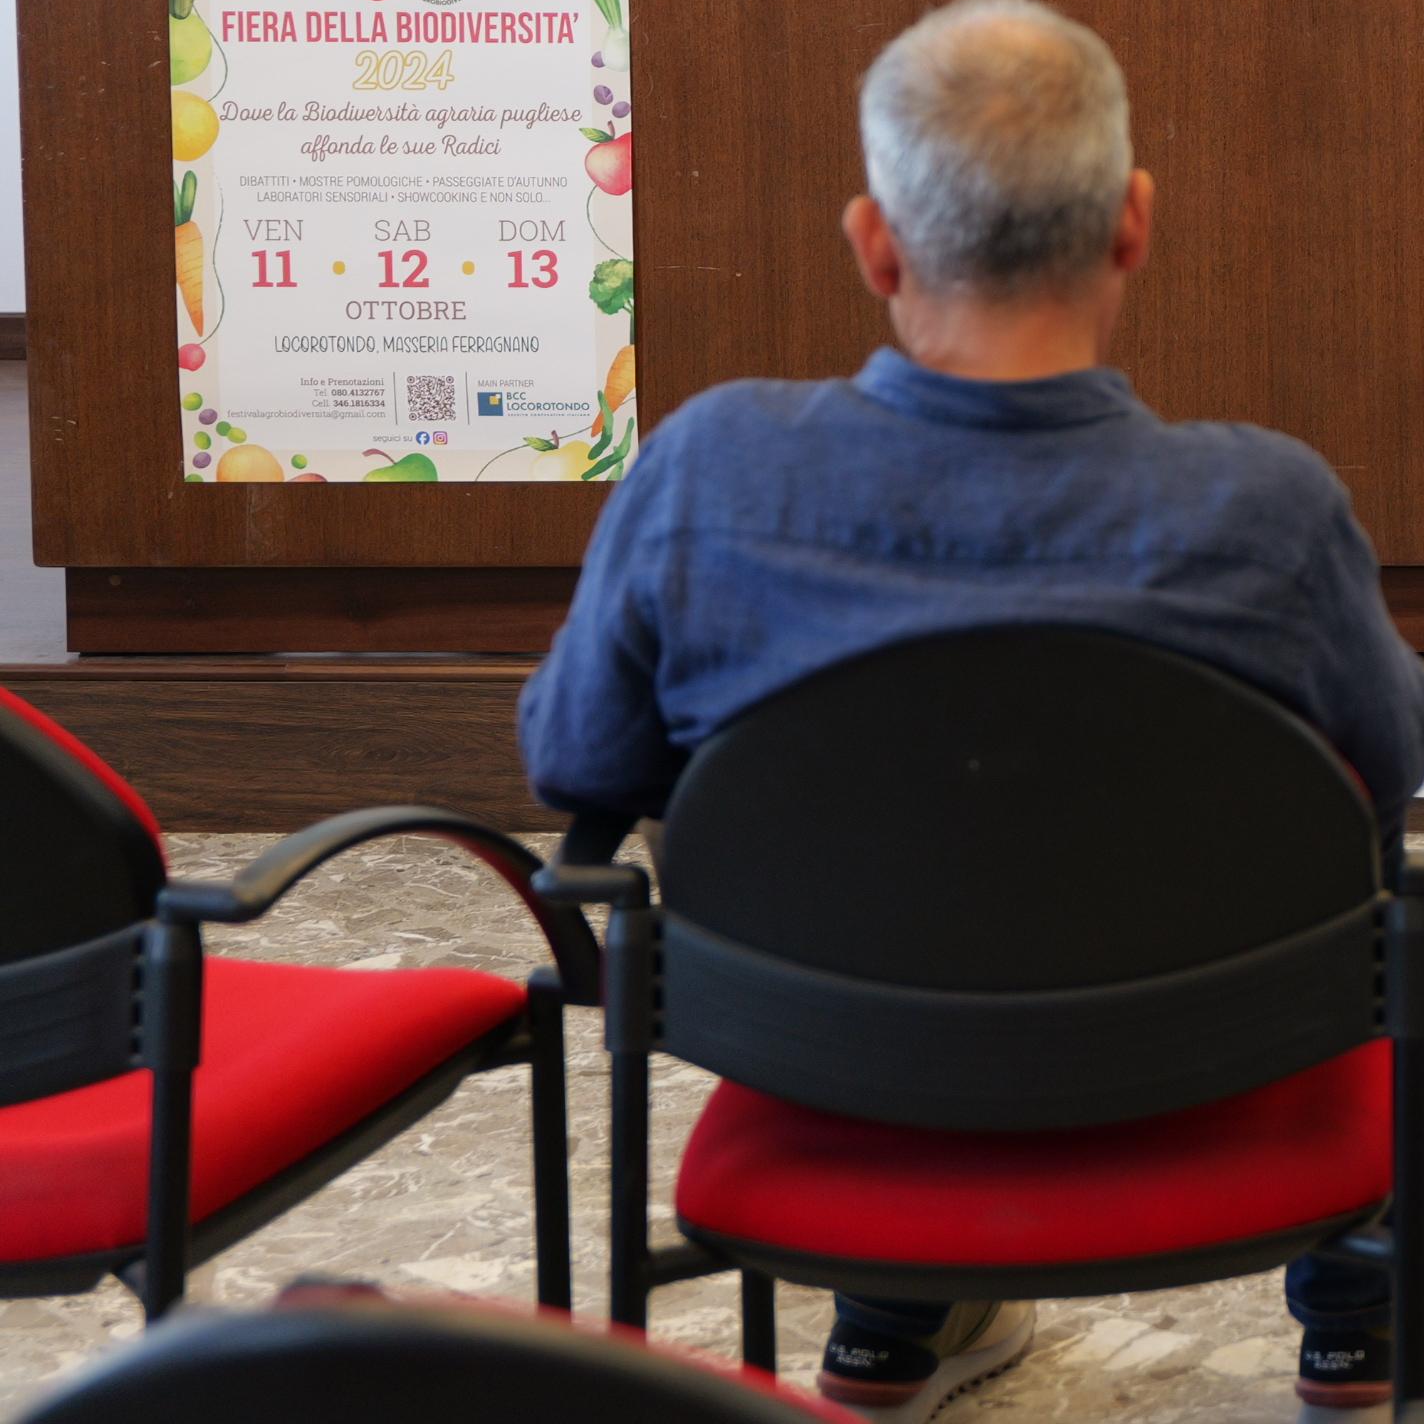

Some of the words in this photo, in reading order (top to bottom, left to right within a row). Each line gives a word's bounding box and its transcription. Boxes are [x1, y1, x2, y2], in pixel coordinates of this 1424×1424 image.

[222, 11, 297, 42] FIERA
[306, 11, 387, 42] DELLA
[396, 12, 578, 43] BIODIVERSITA'
[352, 49, 455, 91] 2024
[218, 101, 273, 124] Dove
[278, 101, 298, 121] la
[302, 101, 421, 121] Biodiversità
[425, 106, 497, 129] agraria
[500, 102, 584, 132] pugliese
[301, 135, 375, 162] affonda
[380, 135, 398, 154] le
[402, 141, 436, 154] sue
[442, 135, 501, 156] Radici
[240, 176, 289, 186] DIBATTITI
[300, 176, 343, 187] MOSTRE
[347, 176, 422, 187] POMOLOGICHE
[433, 176, 504, 187] PASSEGGIATE
[507, 176, 567, 187] D'AUTUNNO
[257, 192, 322, 202] LABORATORI
[326, 192, 388, 202] SENSORIALI
[398, 192, 477, 203] SHOWCOOKING
[490, 192, 512, 203] NON
[243, 220, 303, 241] VEN
[375, 220, 430, 241] SAB
[499, 220, 566, 241] DOM
[252, 250, 297, 287] 11
[378, 250, 429, 288] 12
[508, 250, 558, 288] 13
[346, 301, 466, 320] OTTOBRE
[384, 336, 447, 353] MASSERIA
[452, 336, 539, 353] FERRAGNANO
[301, 378, 317, 386] Info
[328, 378, 384, 386] Prenotazioni
[507, 392, 526, 400] BCC
[507, 402, 589, 410] LOCOROTONDO
